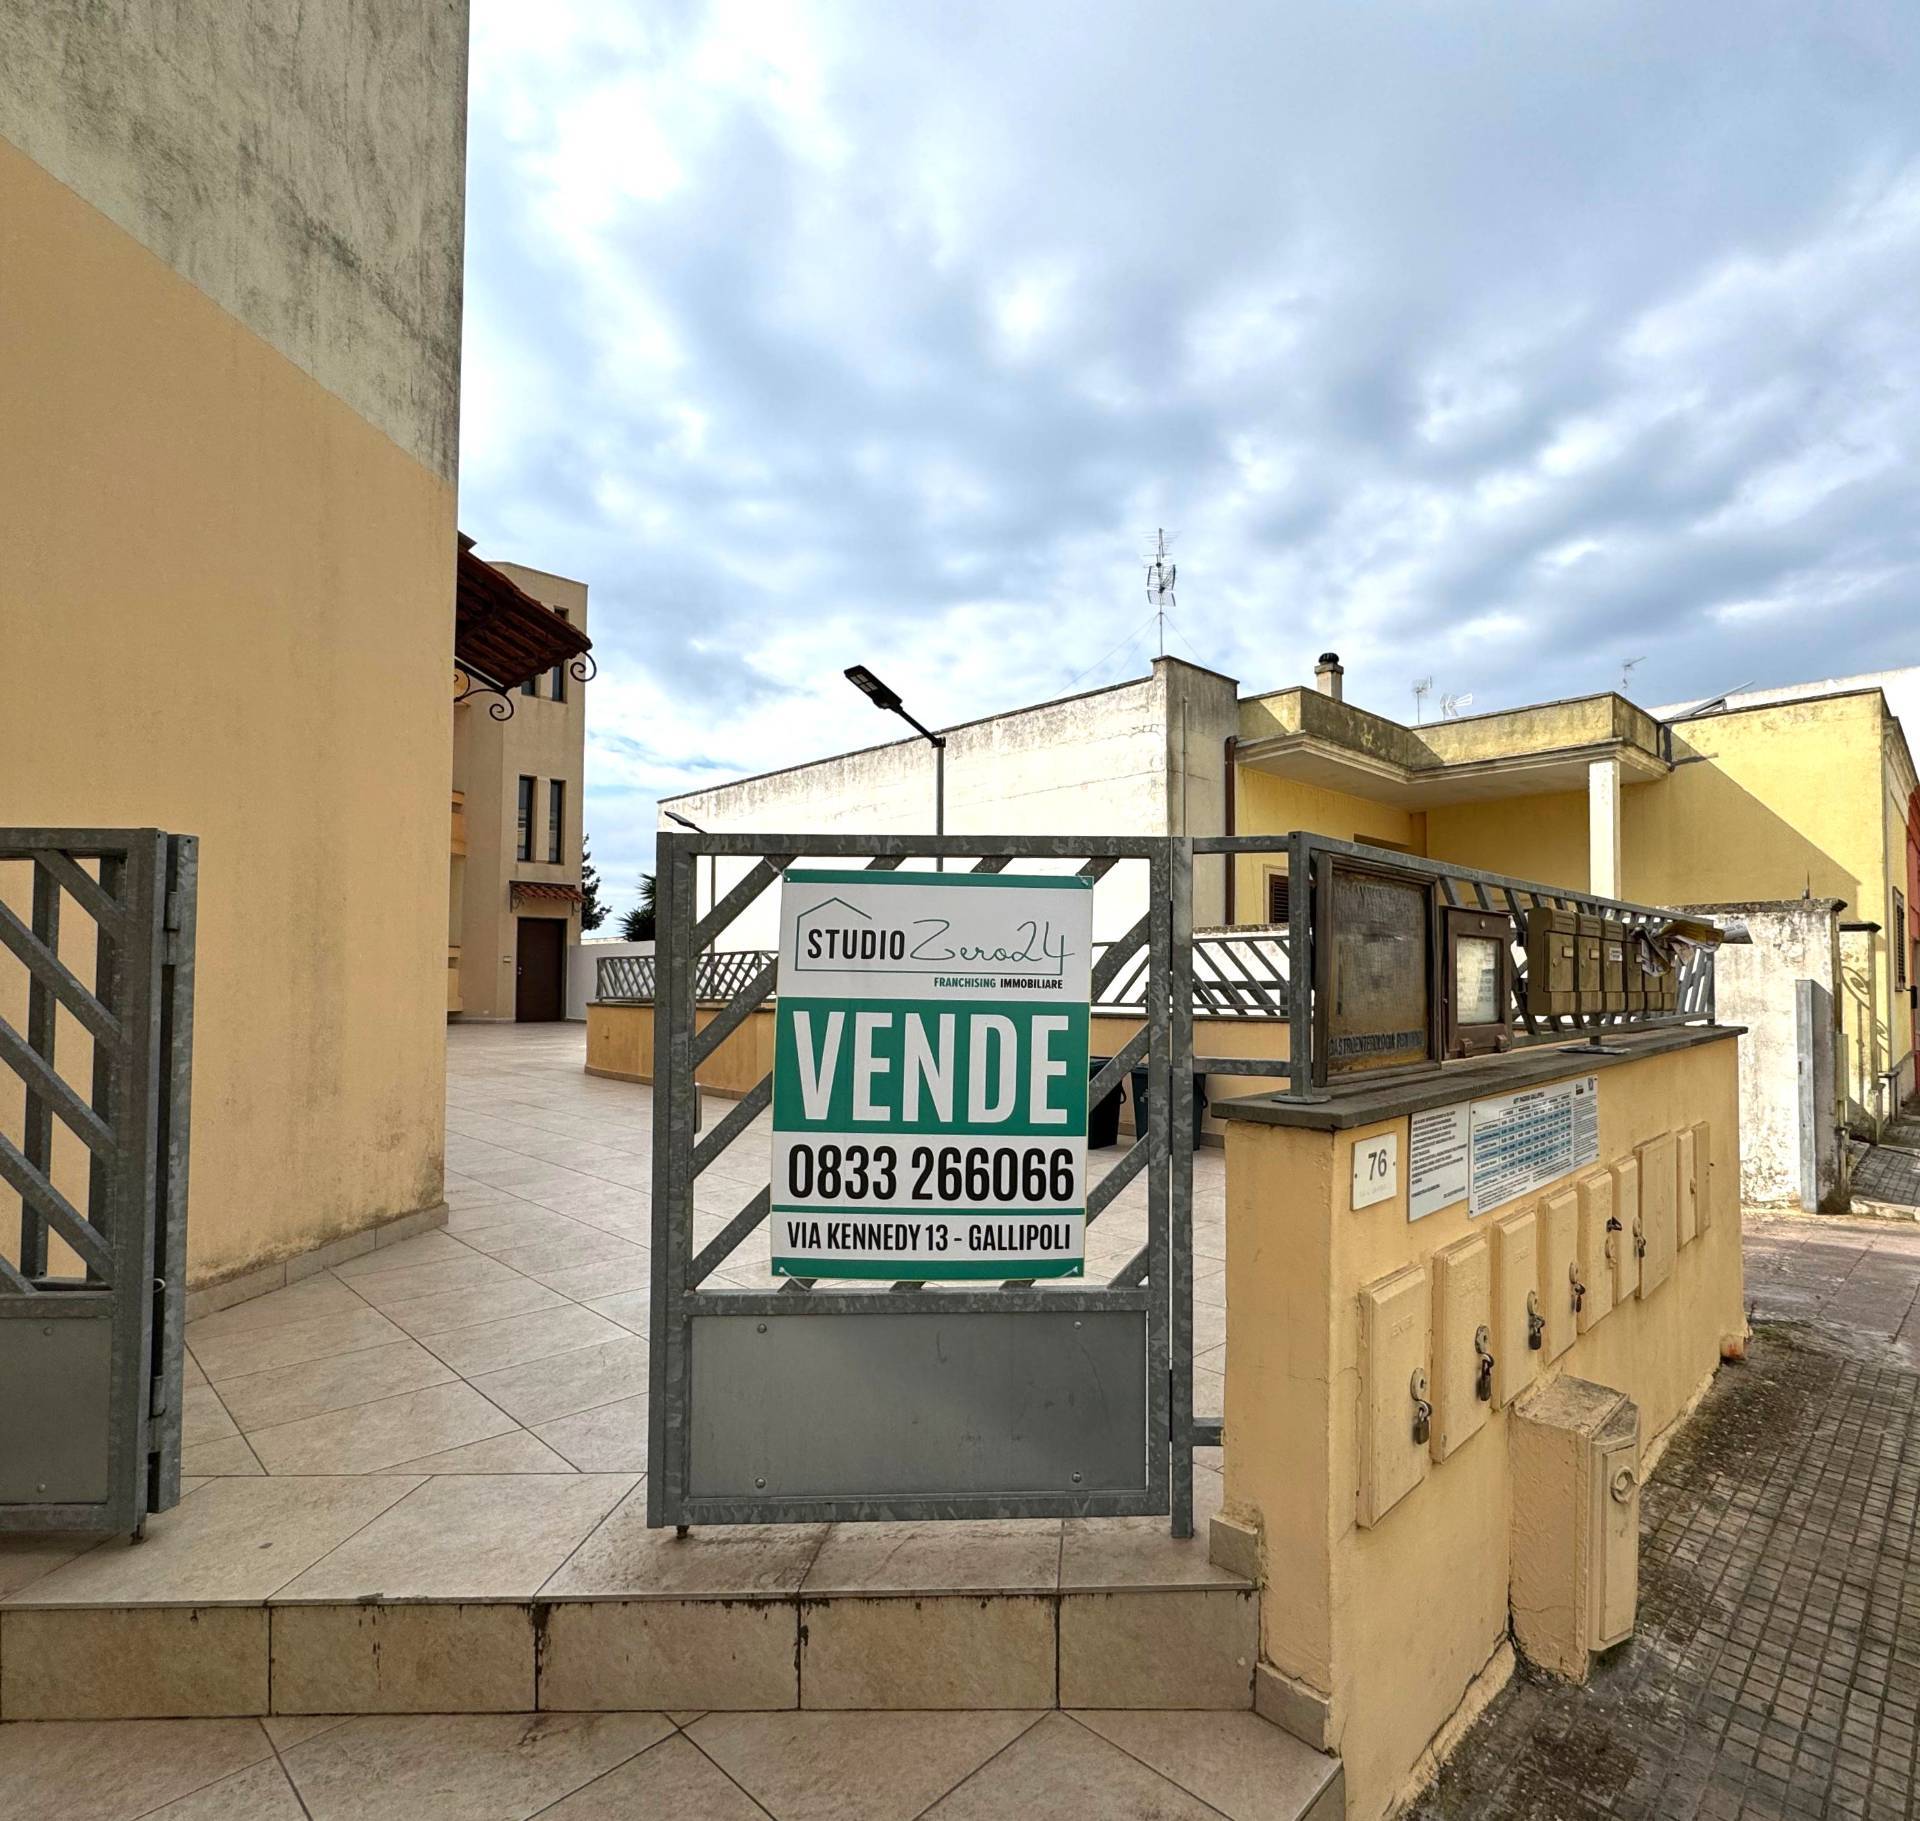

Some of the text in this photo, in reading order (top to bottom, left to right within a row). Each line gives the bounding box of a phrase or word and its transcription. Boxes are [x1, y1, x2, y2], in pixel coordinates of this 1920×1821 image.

[807, 919, 1075, 962] STUDIO Zero24
[933, 977, 1063, 990] FRANCHISING IMMOBILIARE
[792, 1010, 1069, 1124] VENDE
[788, 1143, 1074, 1201] 0833 266066
[1368, 1148, 1387, 1181] 76
[787, 1221, 822, 1250] VIA
[828, 1222, 922, 1250] KENNEDY
[925, 1224, 949, 1251] 13
[969, 1224, 1070, 1251] GALLIPOLI
